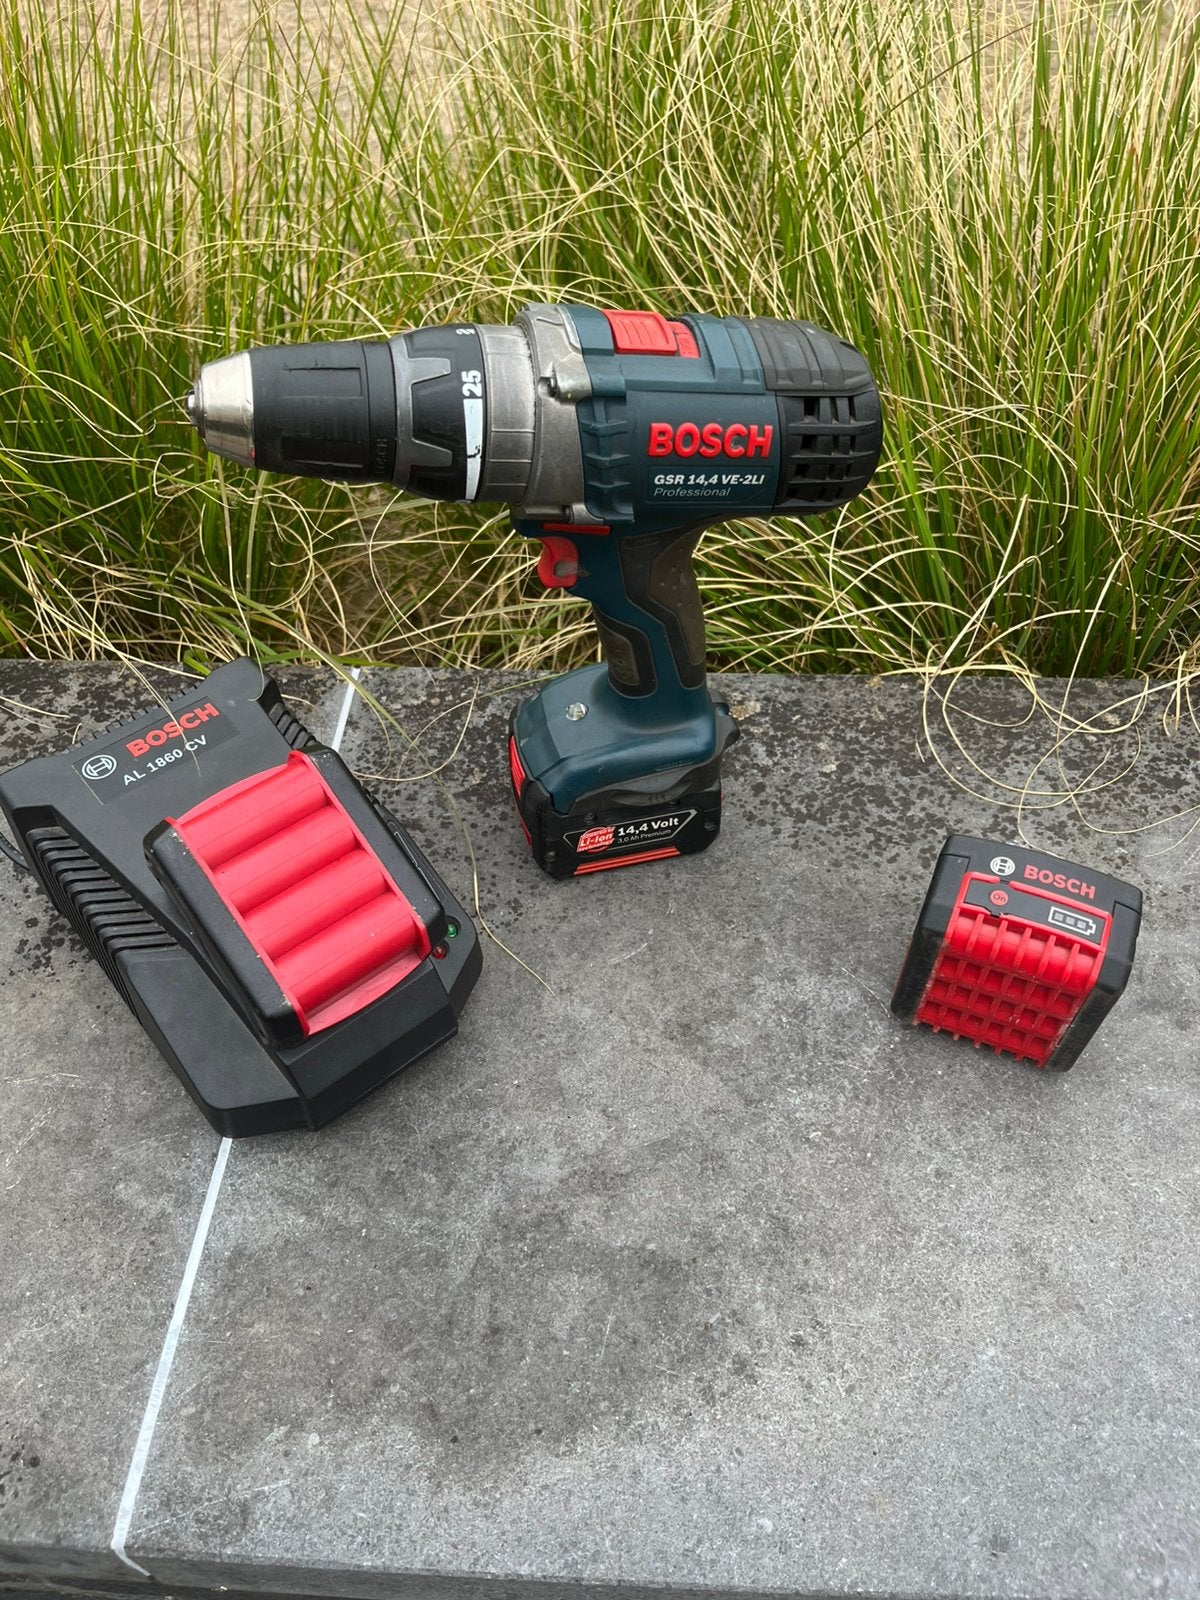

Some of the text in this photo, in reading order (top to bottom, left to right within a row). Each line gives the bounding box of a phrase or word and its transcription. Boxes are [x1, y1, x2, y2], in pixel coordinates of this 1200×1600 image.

[461, 370, 482, 397] 25
[648, 422, 773, 458] BOSCH
[653, 487, 731, 497] Professional
[654, 474, 765, 487] GSR 14,4 VE-2LI
[125, 702, 220, 758] BOSCH
[123, 734, 207, 786] AL 1860 CV
[617, 817, 680, 837] 14,4 Volt
[617, 829, 672, 844] 3,0 Ah Premium
[1023, 864, 1096, 899] BOSCH
